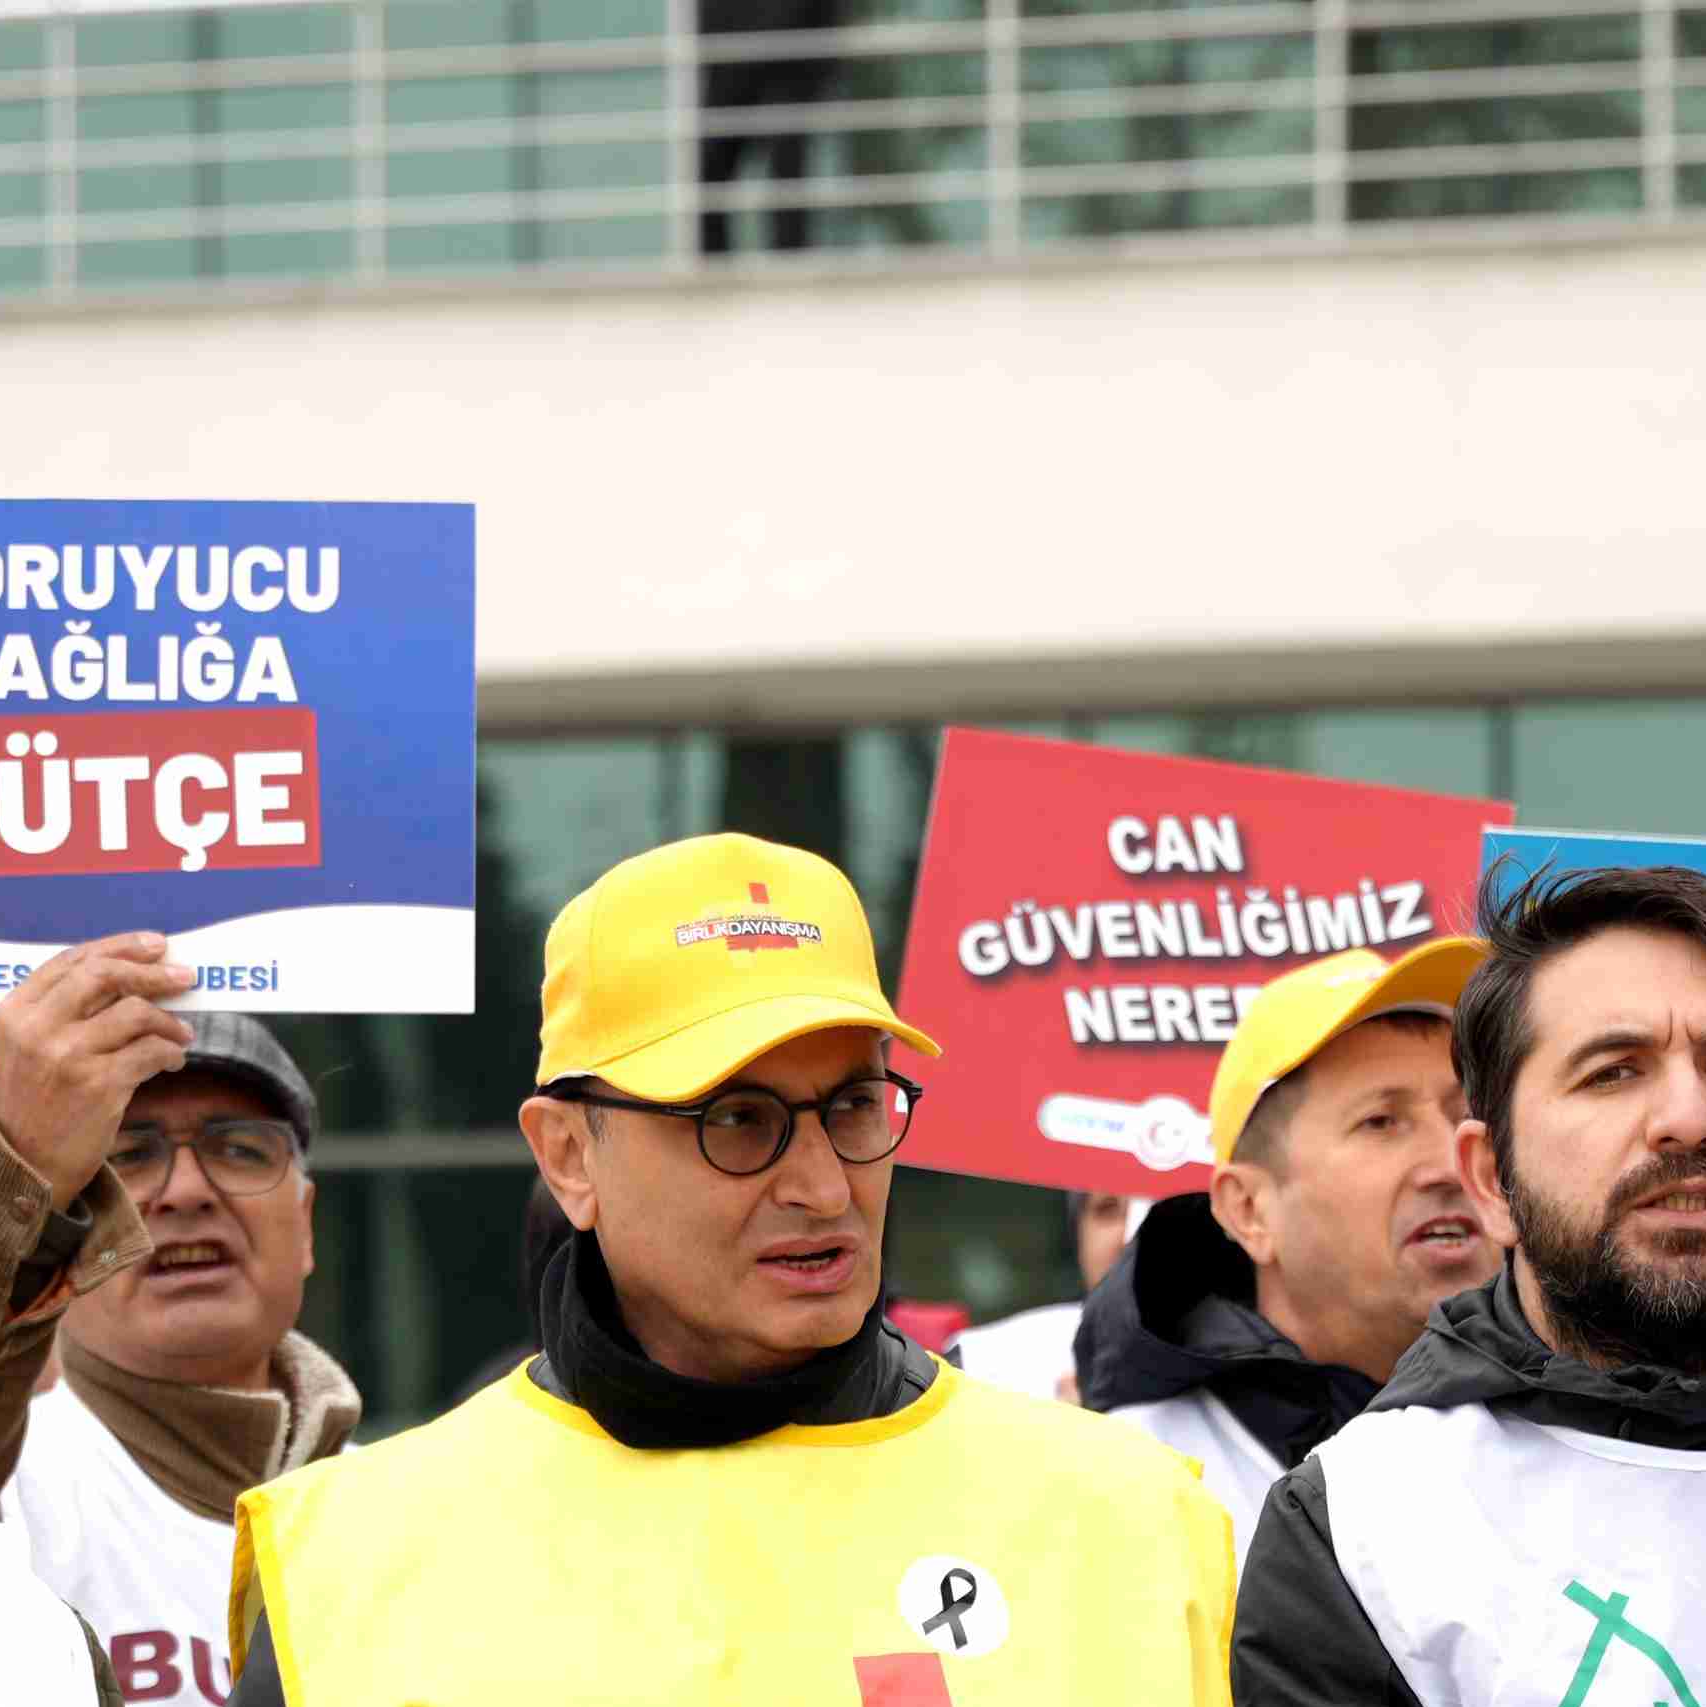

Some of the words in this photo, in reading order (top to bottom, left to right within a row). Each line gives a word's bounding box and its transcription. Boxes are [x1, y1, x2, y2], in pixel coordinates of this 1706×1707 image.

[1106, 815, 1243, 874] CAN
[958, 879, 1433, 976] GÜVENLİĞİMİZ
[191, 960, 278, 991] UBESİ
